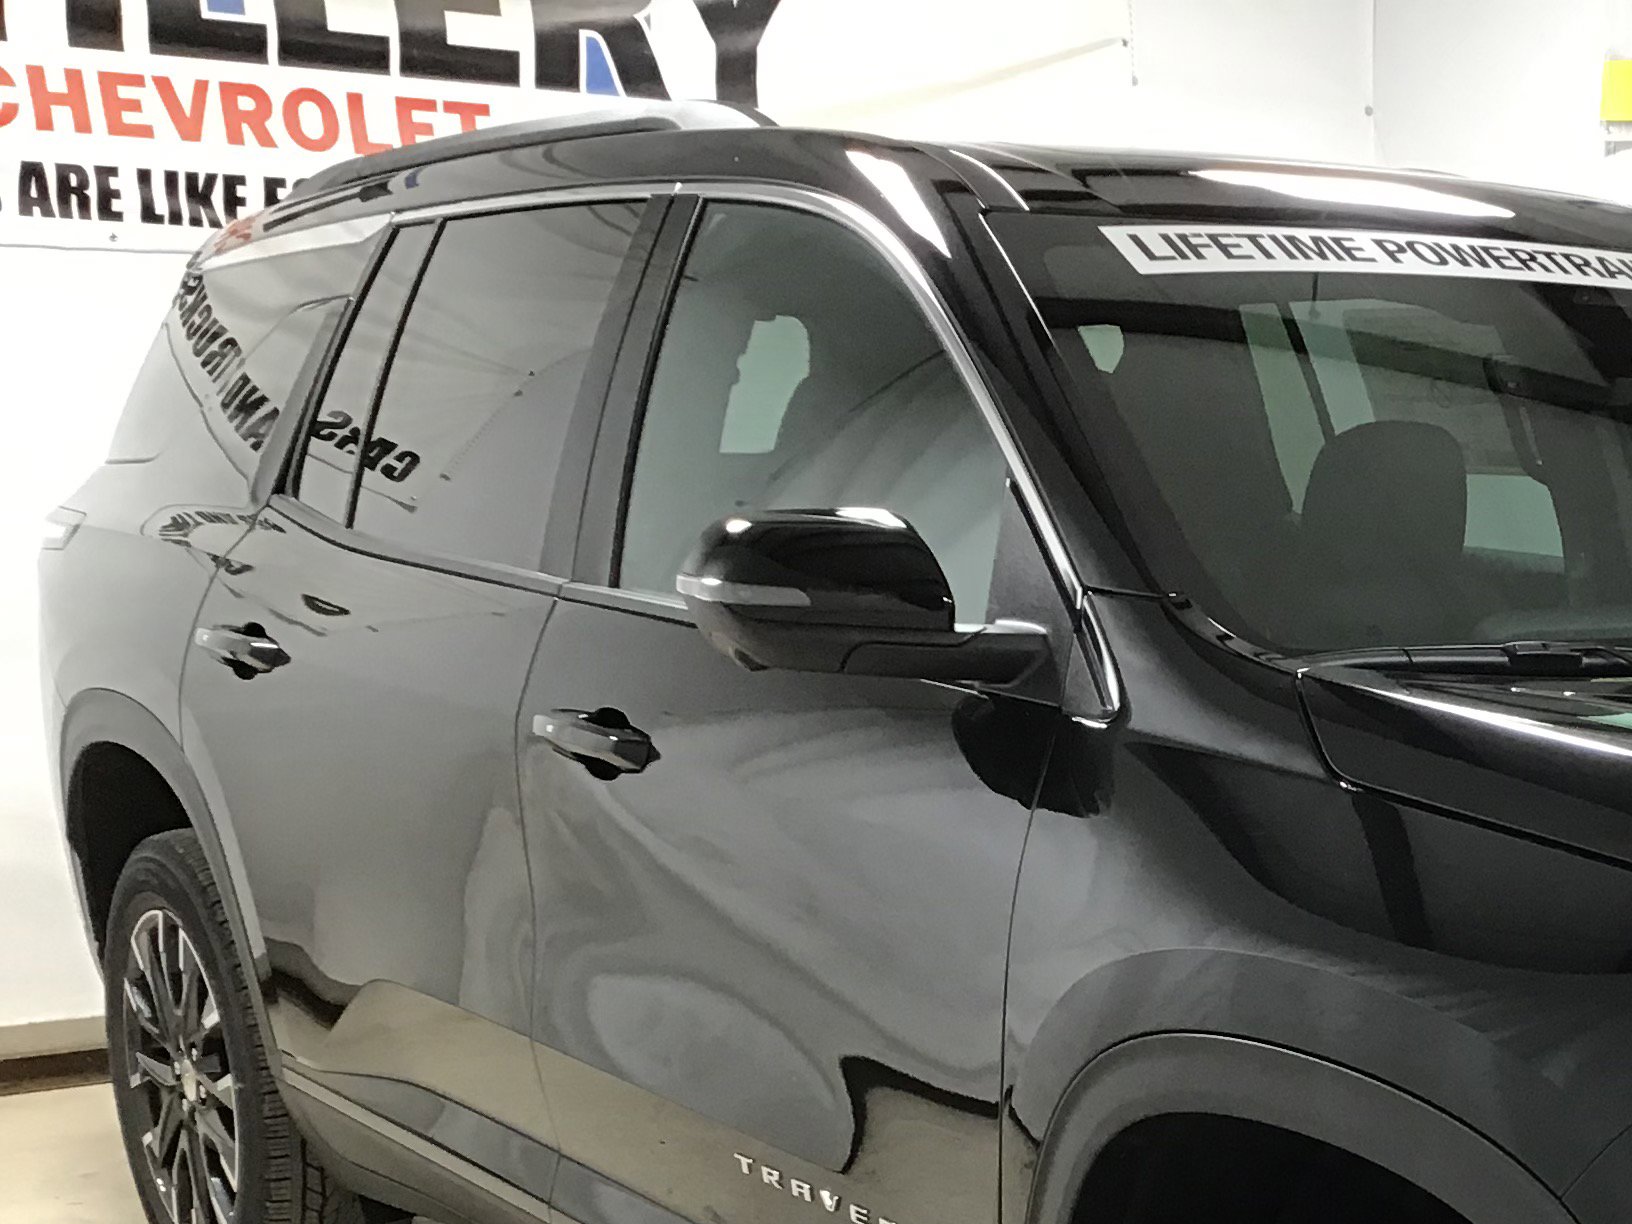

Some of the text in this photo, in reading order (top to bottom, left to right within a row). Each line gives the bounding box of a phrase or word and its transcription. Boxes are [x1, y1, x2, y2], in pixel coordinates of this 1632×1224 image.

[19, 160, 124, 222] ARE
[137, 168, 248, 229] LIKE
[1126, 233, 1377, 263] LIFETIME
